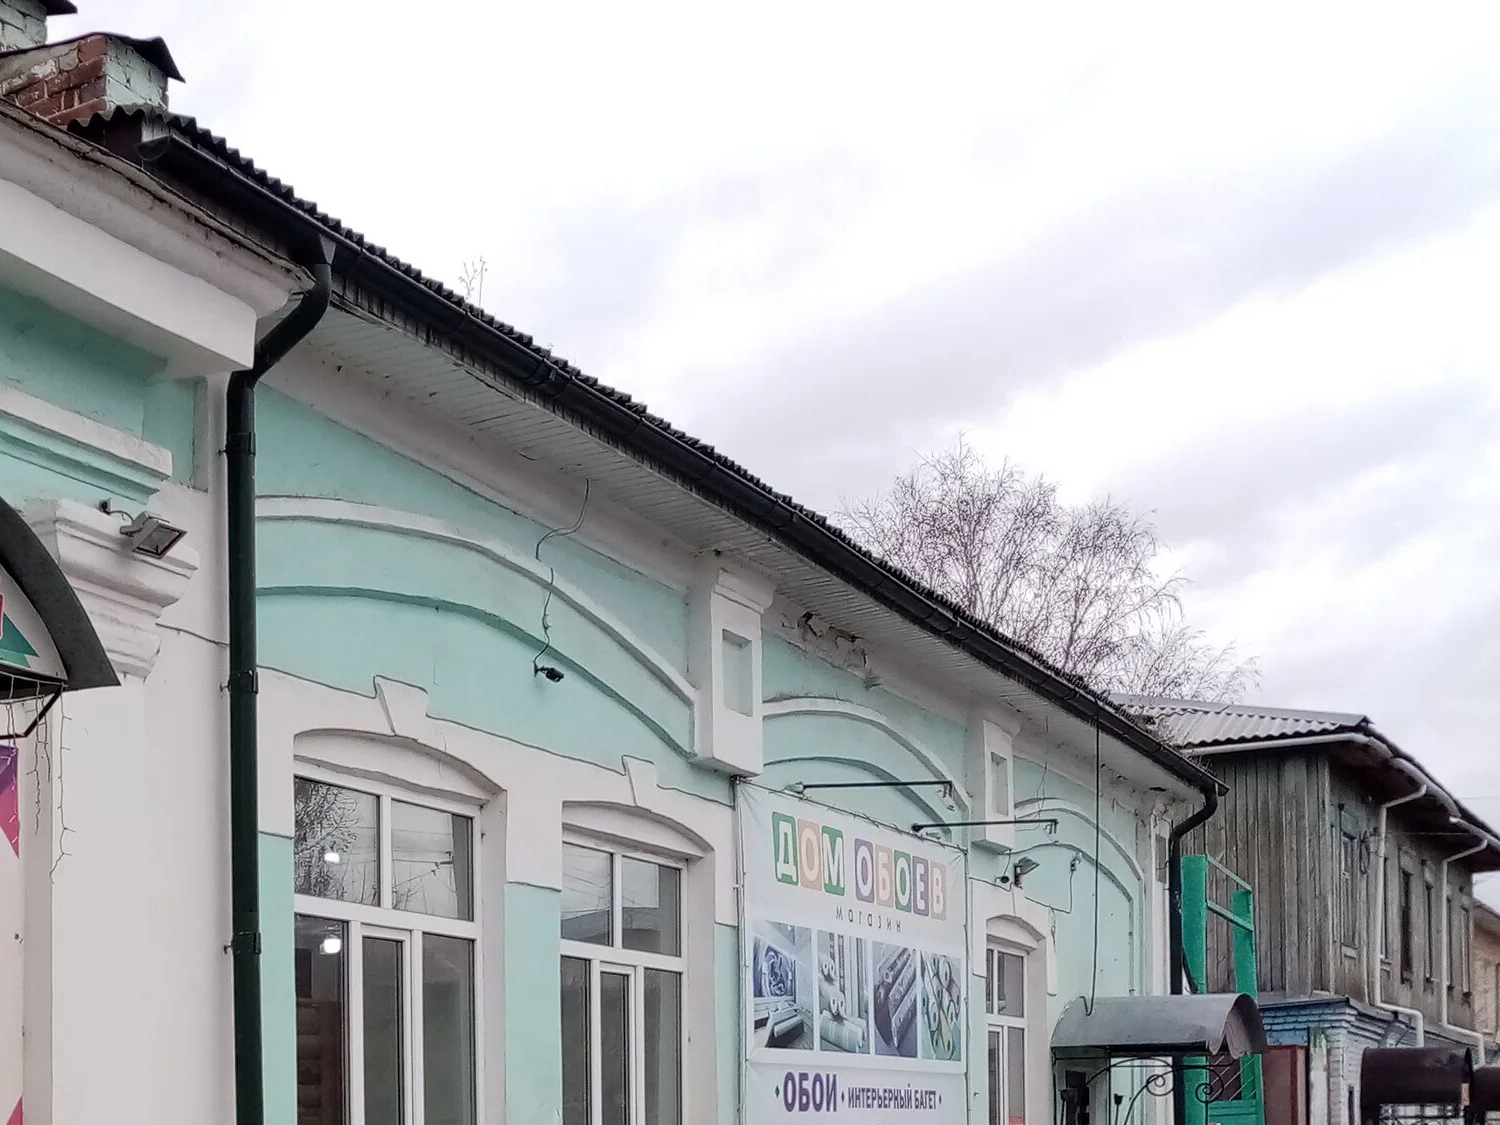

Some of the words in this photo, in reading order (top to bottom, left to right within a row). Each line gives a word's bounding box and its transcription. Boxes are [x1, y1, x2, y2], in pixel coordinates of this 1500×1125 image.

[774, 818, 845, 891] ДОМ
[855, 840, 945, 916] ОБОЕВ
[783, 1071, 838, 1112] ОБОИ
[848, 1083, 912, 1109] ИНТЕРЬЕРНЫЙ
[914, 1089, 937, 1110] БАГЕТ
